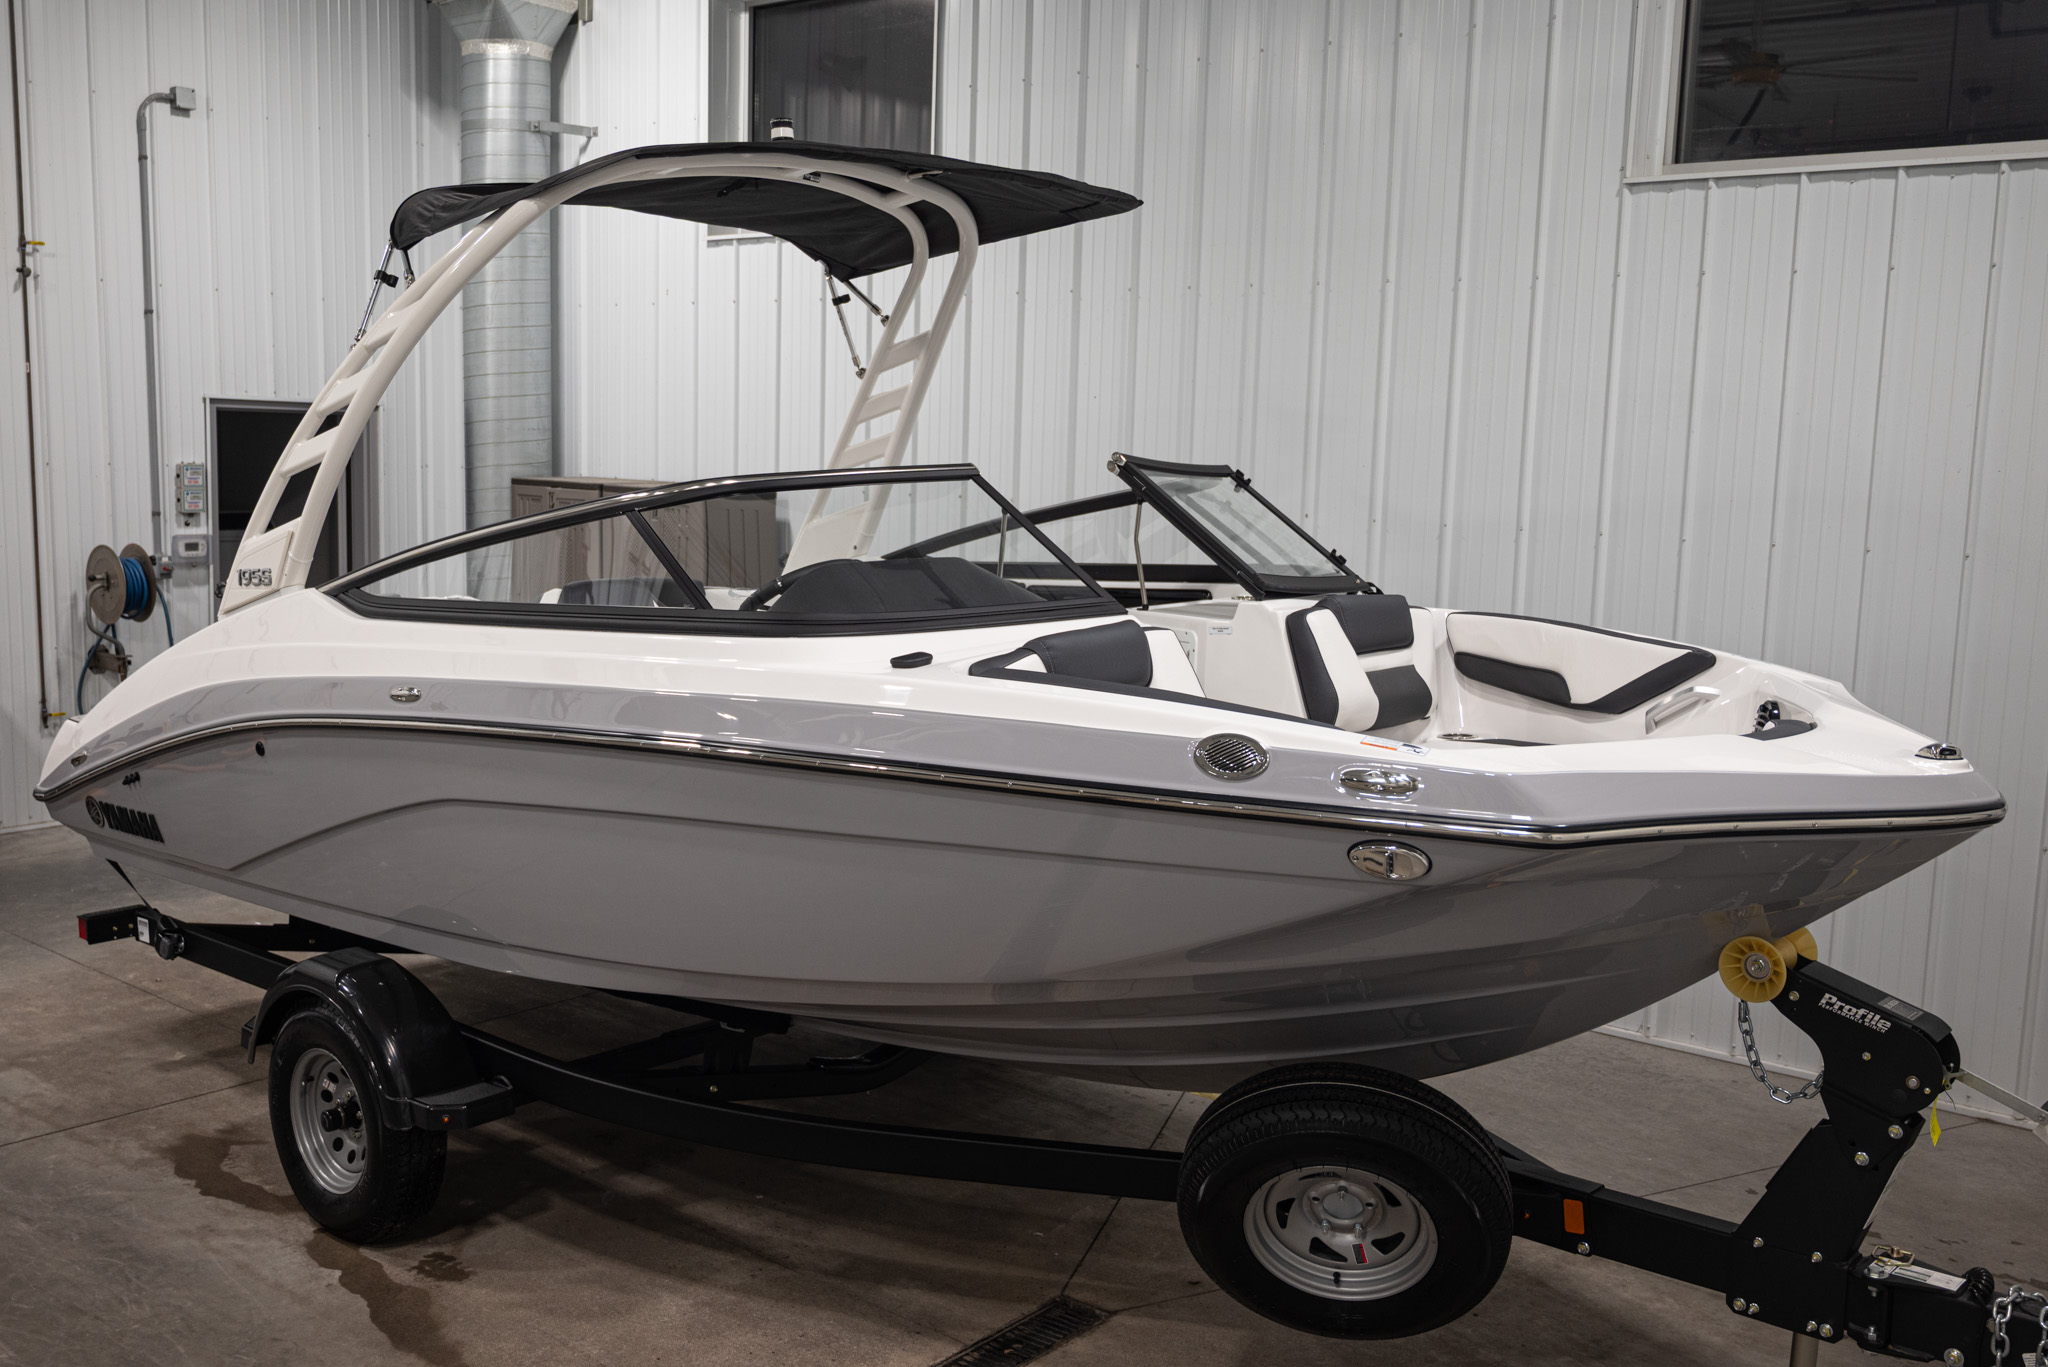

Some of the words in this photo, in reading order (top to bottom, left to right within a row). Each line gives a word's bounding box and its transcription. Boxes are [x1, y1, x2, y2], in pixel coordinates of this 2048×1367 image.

[237, 568, 272, 587] 195S
[98, 800, 165, 844] YAMAHA
[1818, 1002, 1863, 1024] PERFORMANCE
[1864, 1021, 1886, 1034] WINCH
[1820, 992, 1892, 1031] Profile
